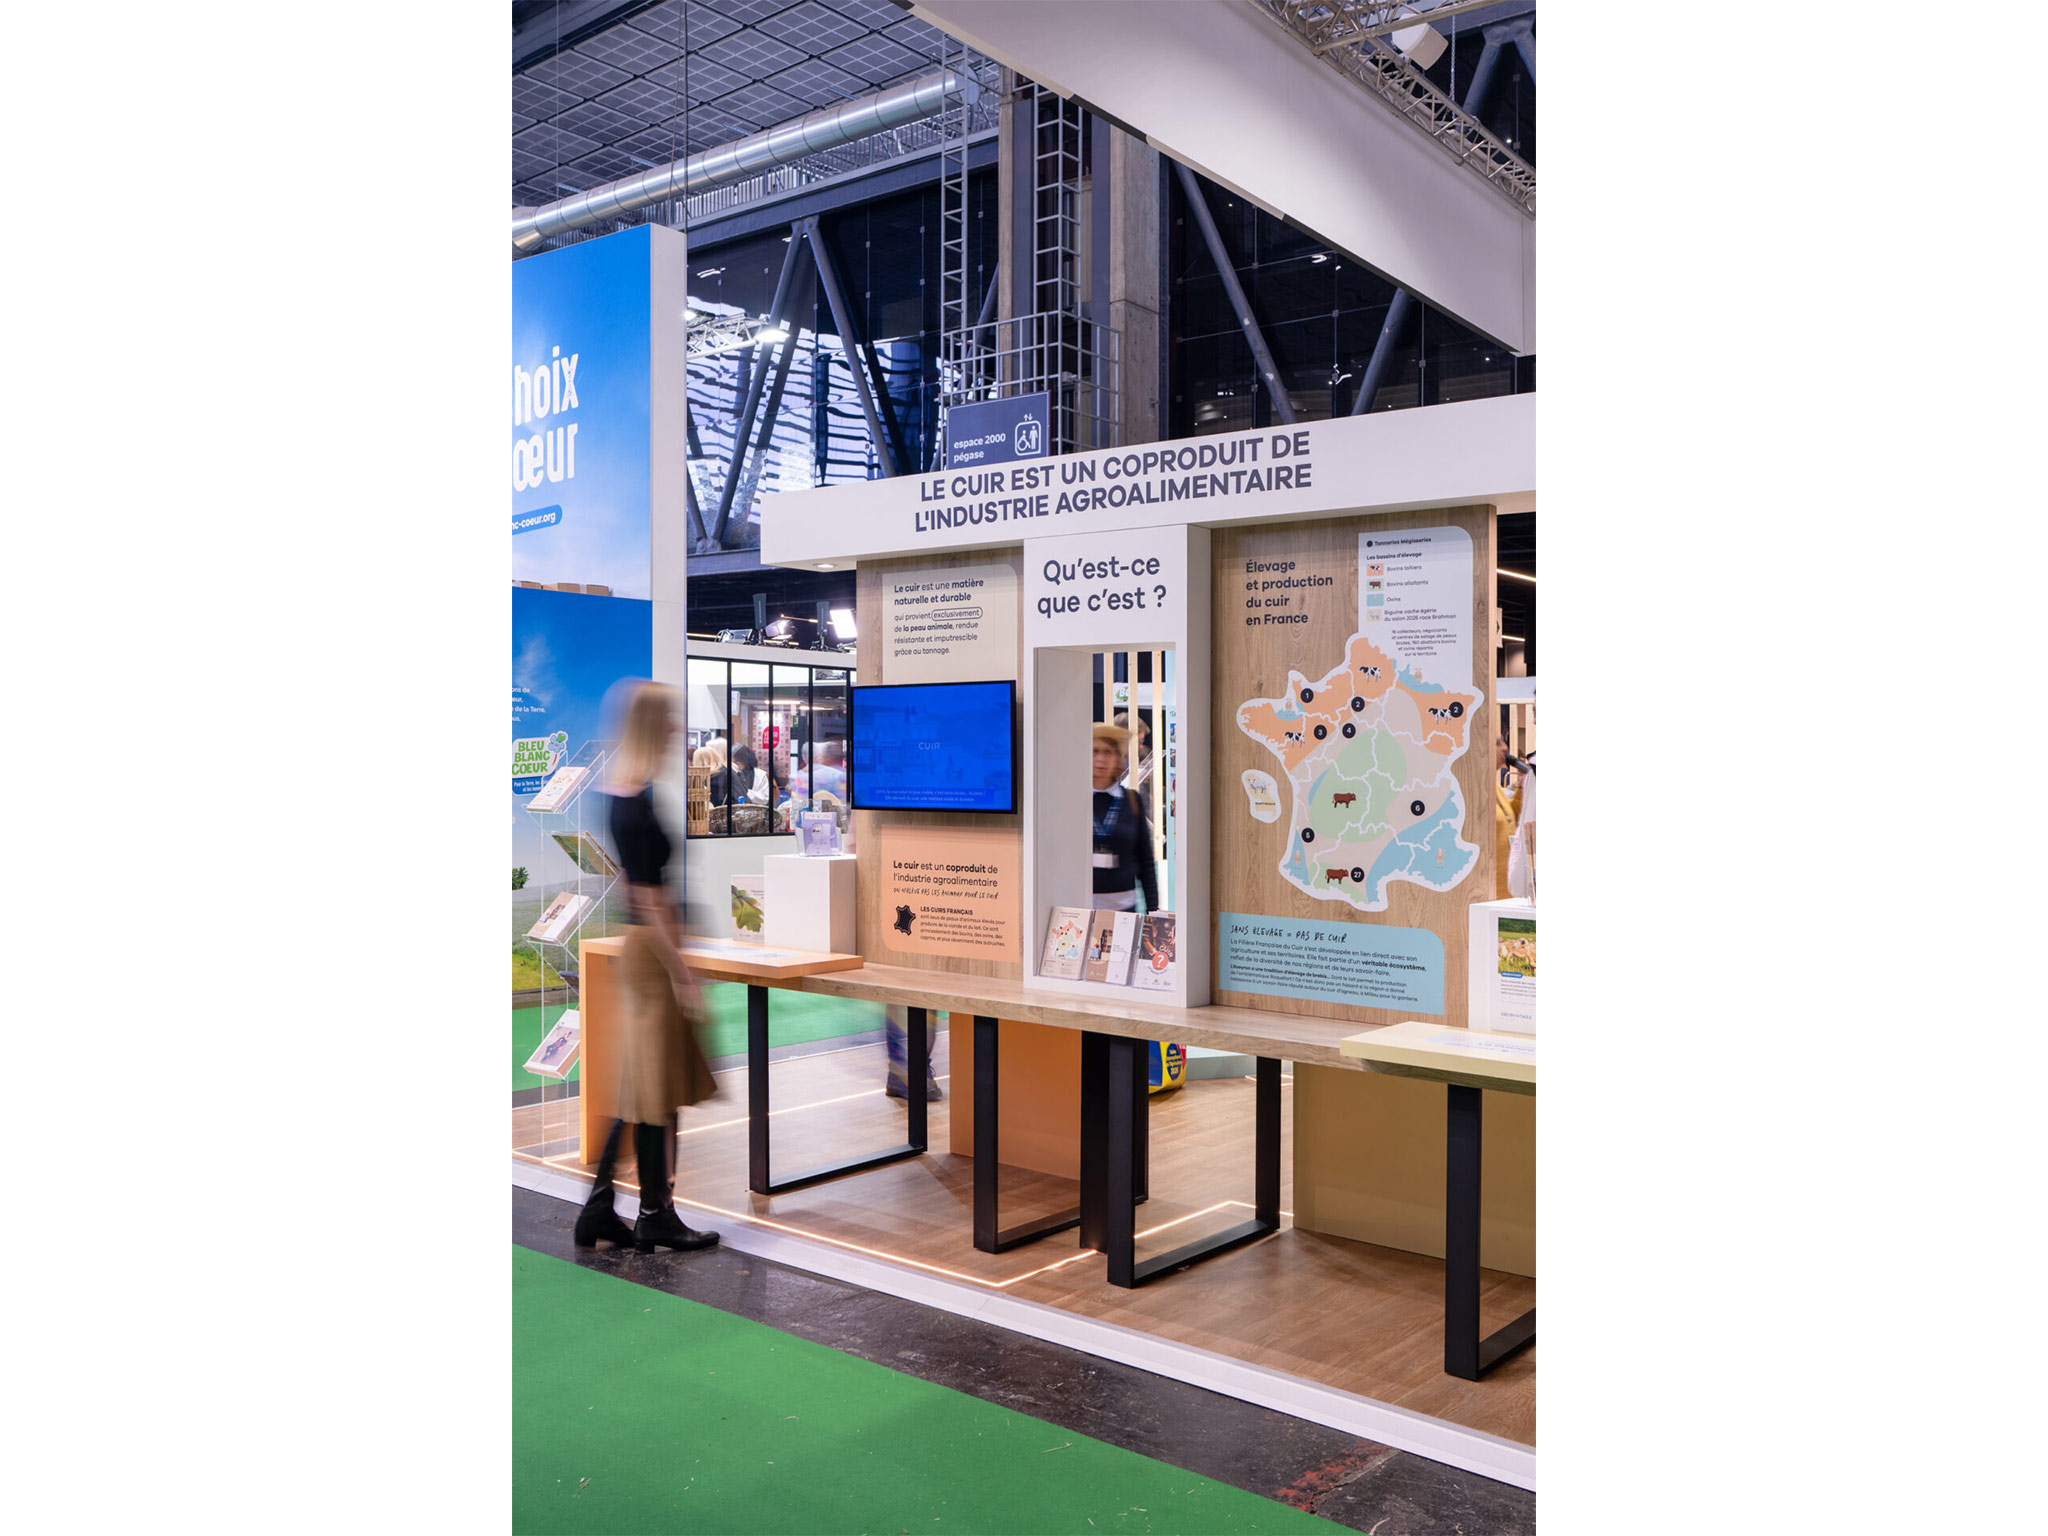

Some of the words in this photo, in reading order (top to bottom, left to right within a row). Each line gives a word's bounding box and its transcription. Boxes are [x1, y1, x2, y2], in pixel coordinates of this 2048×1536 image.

[954, 438, 983, 449] espace
[984, 433, 1006, 444] 2000
[954, 452, 984, 463] pégase
[921, 479, 945, 502] LE
[951, 472, 1004, 497] CUIR
[1011, 465, 1054, 491] EST
[1061, 460, 1097, 484] UN
[1103, 437, 1263, 479] COPRODUIT
[1271, 431, 1310, 459] DE
[915, 494, 1048, 532] L'INDUSTRIE
[1055, 463, 1312, 514] AGROALIMENTAIRE
[1246, 559, 1296, 573] Élevage
[905, 582, 920, 592] cuir
[922, 580, 934, 591] est
[935, 580, 950, 590] une
[952, 578, 984, 588] matière
[1246, 580, 1258, 591] et
[1262, 575, 1333, 592] production
[894, 595, 928, 605] naturelle
[940, 592, 971, 602] durable
[1038, 596, 1080, 618] que
[1154, 585, 1167, 607] ?
[1246, 597, 1262, 608] du
[1265, 595, 1289, 607] cuir
[905, 613, 930, 621] provient
[933, 610, 980, 618] exclusivement
[1246, 617, 1261, 626] en
[1264, 614, 1308, 624] France
[934, 633, 977, 642] imputrescible
[894, 648, 912, 657] grâce
[518, 740, 544, 752] BLEU
[515, 750, 550, 762] BLANC
[904, 861, 919, 869] cuir
[946, 864, 986, 873] coproduit
[988, 865, 998, 874] de
[933, 876, 998, 887] agroalimentaire
[1231, 925, 1249, 935] SANS
[1296, 931, 1310, 941] PAS
[1314, 932, 1325, 941] DE
[1328, 933, 1347, 943] CUIR
[1159, 946, 1173, 958] CUIR
[1157, 954, 1164, 967] ?
